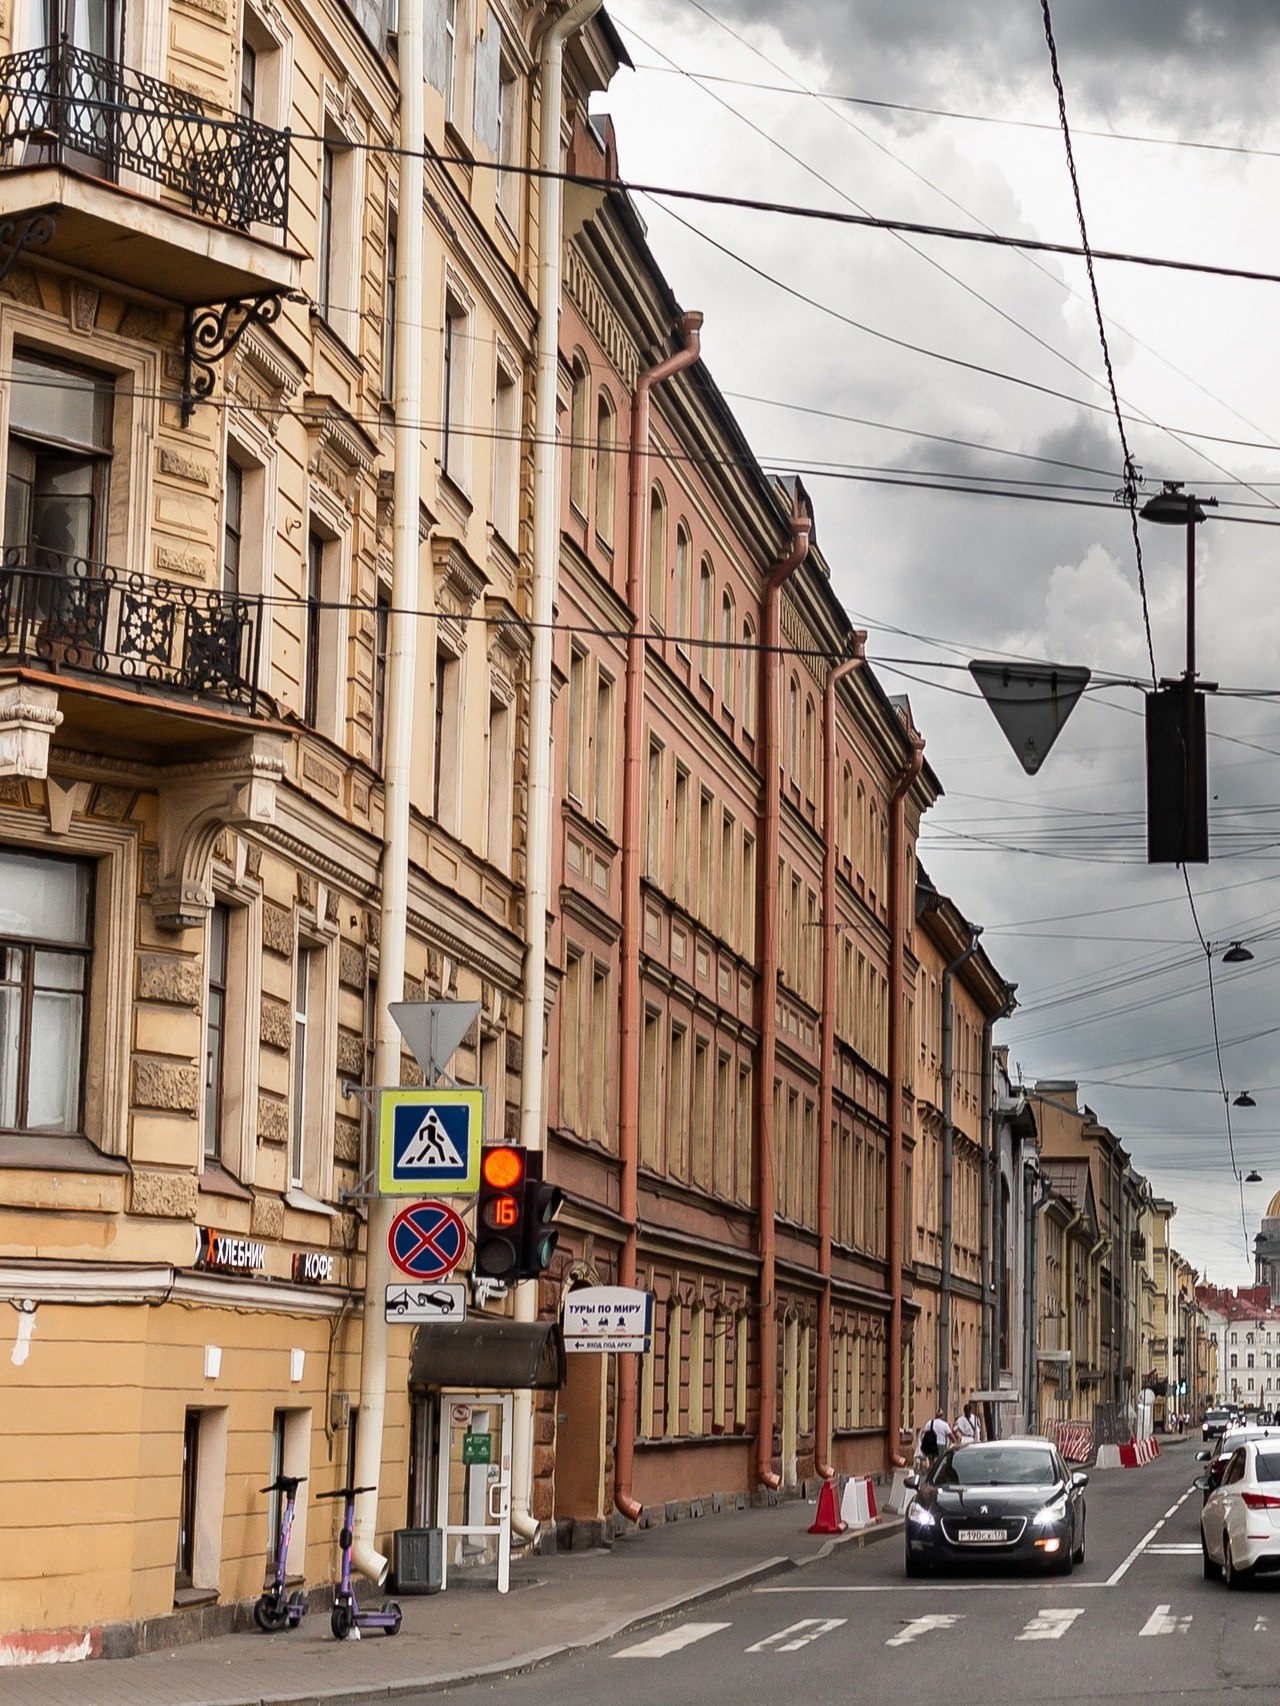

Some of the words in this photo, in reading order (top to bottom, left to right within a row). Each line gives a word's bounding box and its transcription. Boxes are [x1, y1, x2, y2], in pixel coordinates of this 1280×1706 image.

[496, 1197, 516, 1226] 16
[217, 1238, 266, 1269] ХЛЕБНИК
[305, 1253, 333, 1280] КОФЕ
[569, 1305, 595, 1314] ТУРЫ
[598, 1305, 611, 1313] ПО
[614, 1305, 641, 1313] МИРУ
